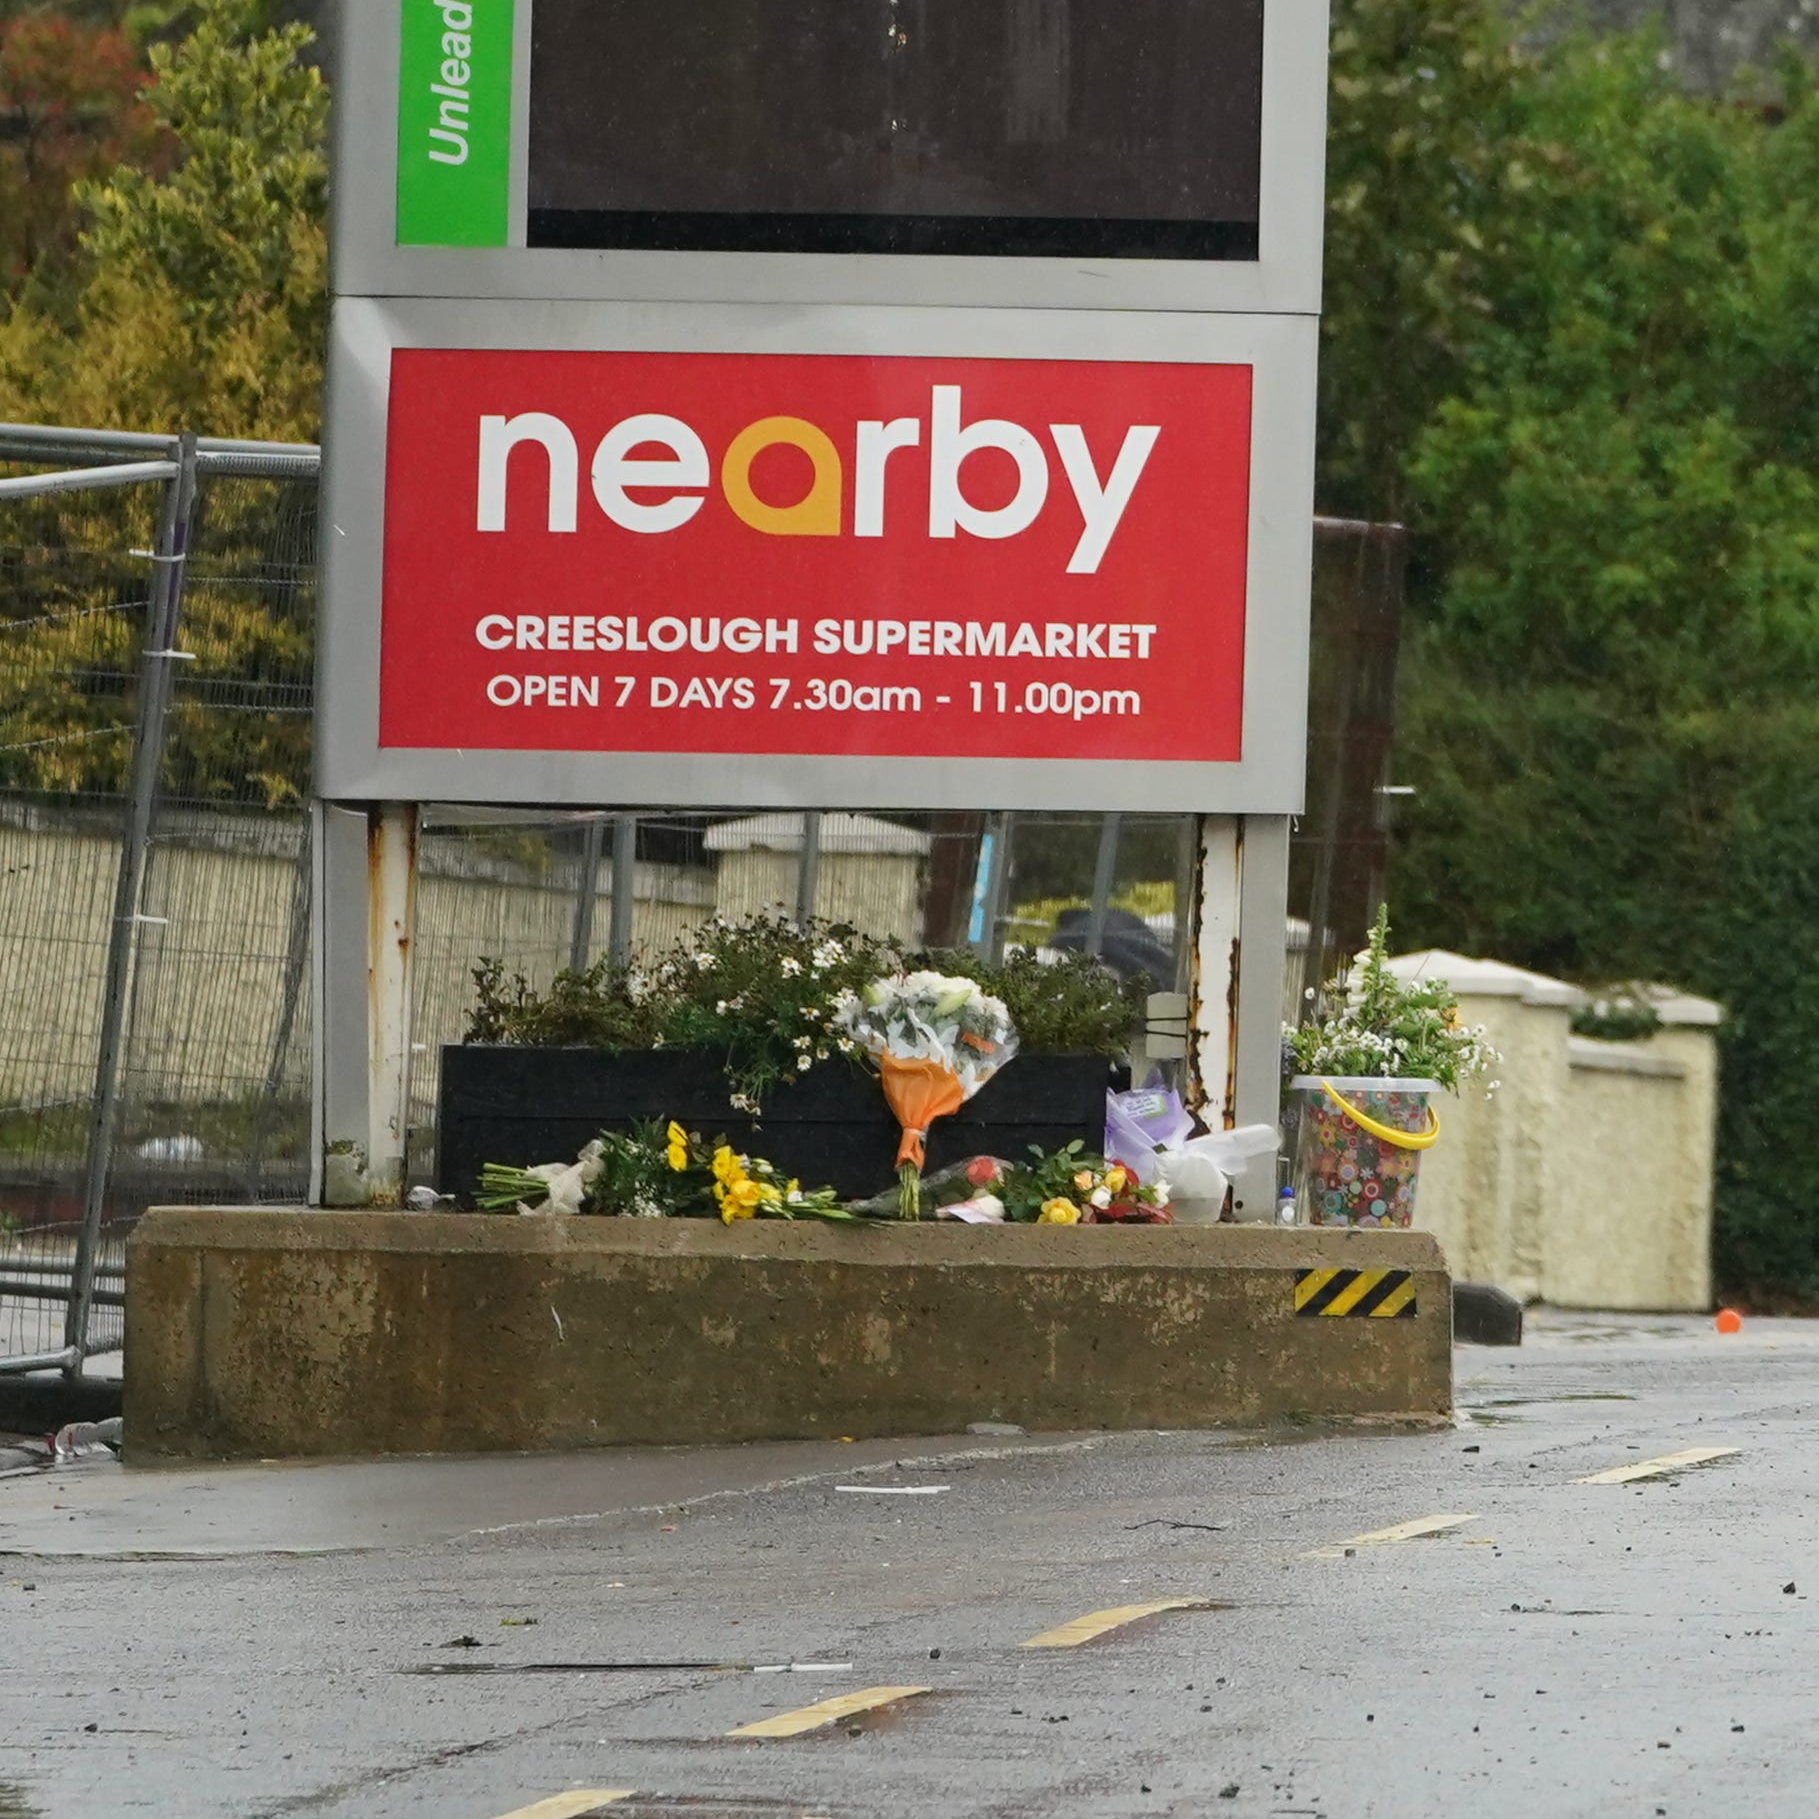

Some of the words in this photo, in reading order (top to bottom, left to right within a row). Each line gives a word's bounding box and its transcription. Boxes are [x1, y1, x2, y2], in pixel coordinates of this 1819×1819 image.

[477, 385, 1161, 573] nearby
[476, 615, 798, 653] CREESLOUGH
[814, 619, 1157, 658] SUPERMARKET
[487, 675, 598, 706] OPEN
[615, 677, 635, 707] 7
[651, 677, 755, 709] DAYS
[770, 678, 921, 712] 7.30am
[970, 682, 1140, 720] 11.00pm
